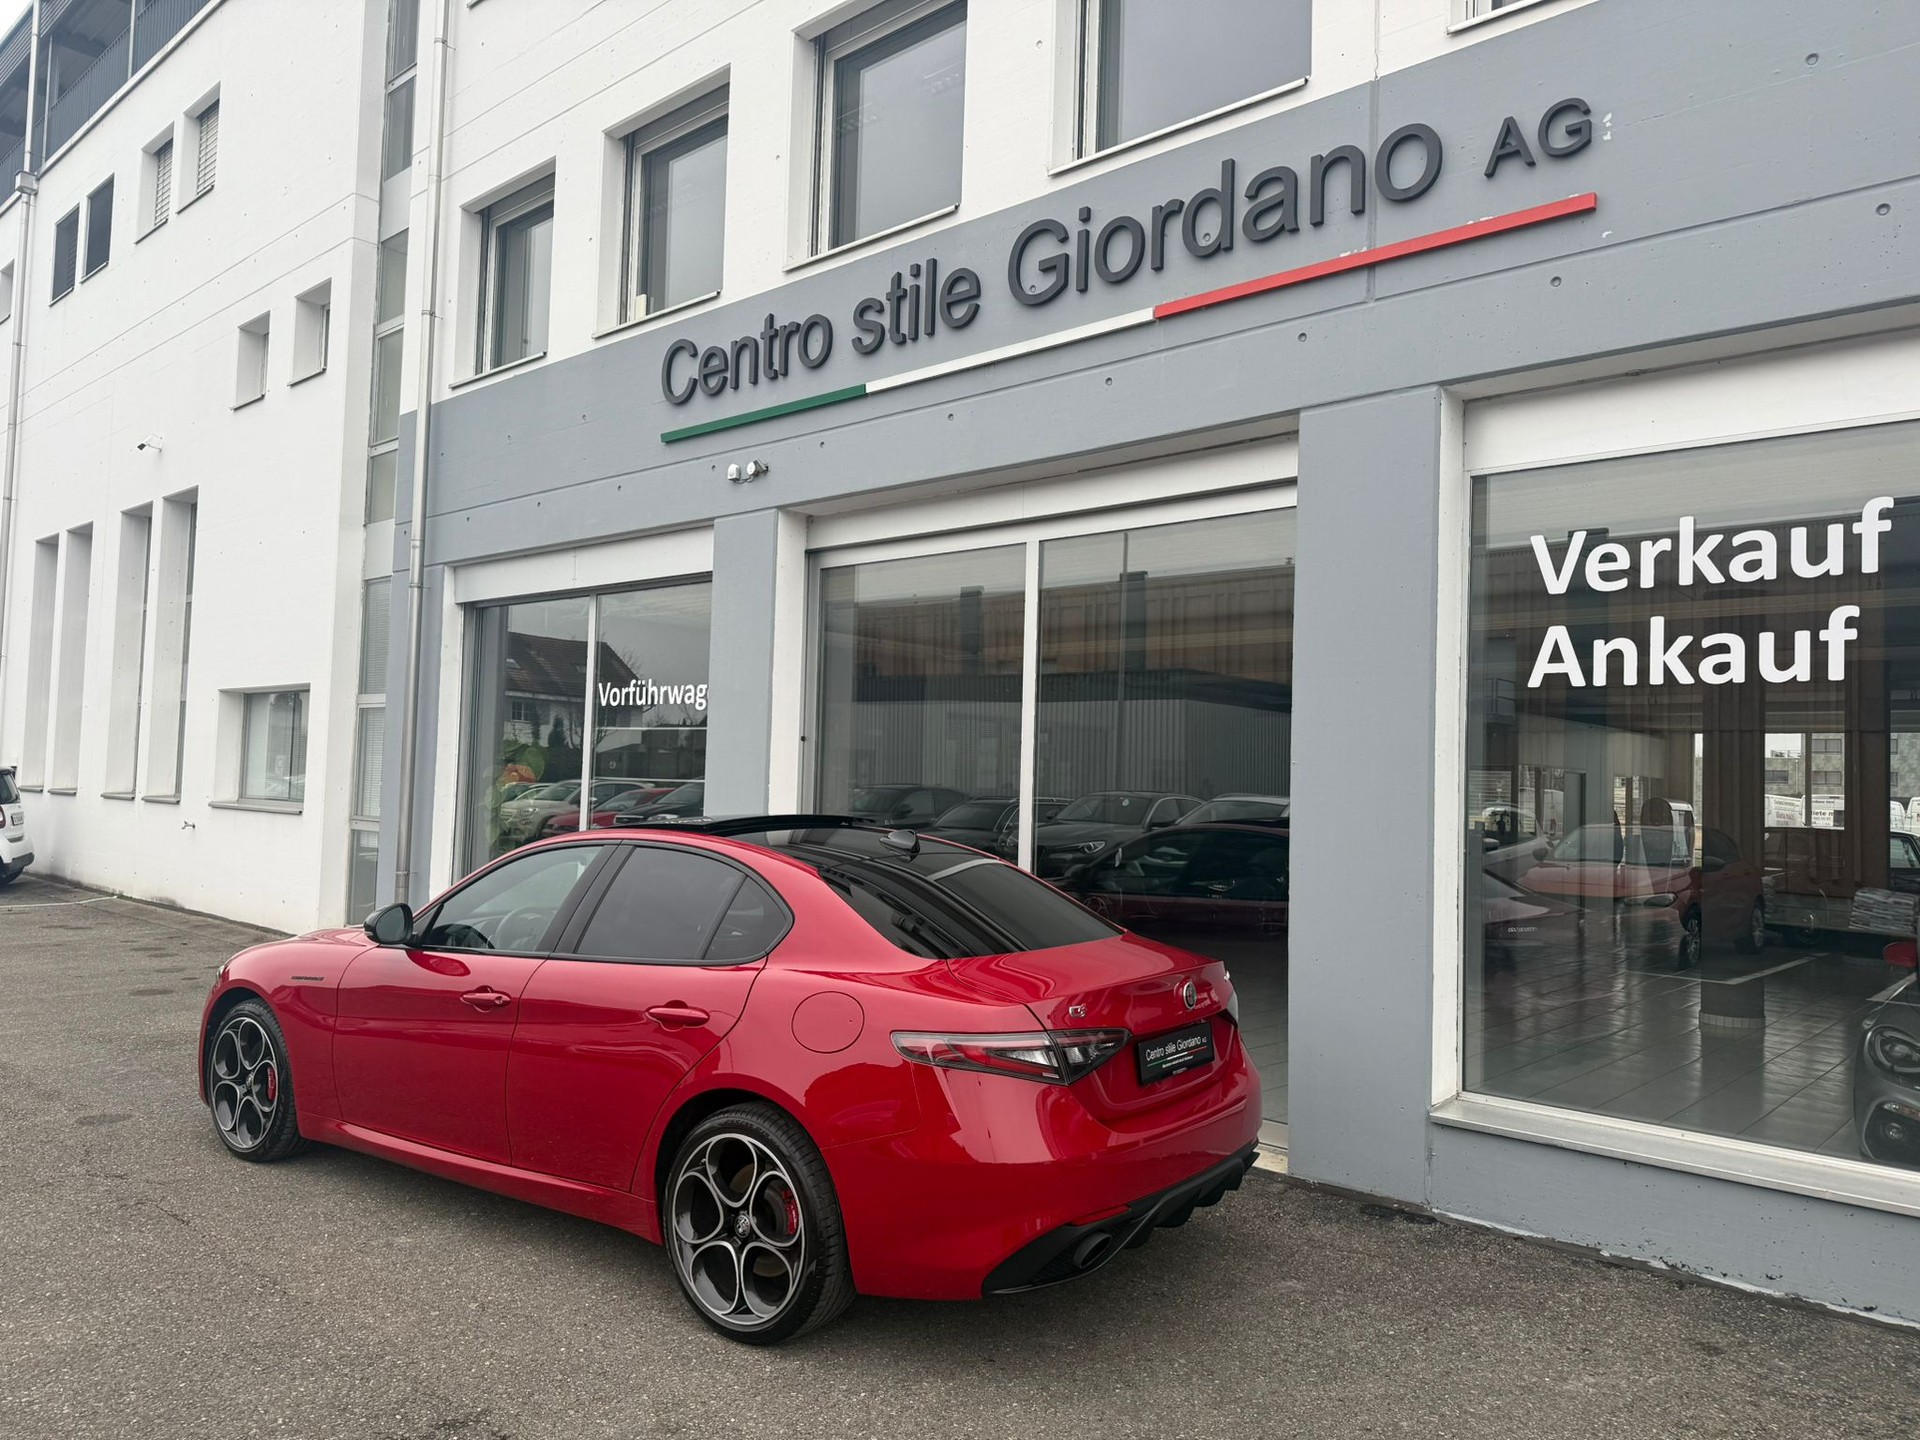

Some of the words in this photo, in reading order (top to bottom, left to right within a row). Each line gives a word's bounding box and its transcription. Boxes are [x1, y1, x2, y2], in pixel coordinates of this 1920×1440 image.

[661, 306, 834, 405] Centro
[851, 258, 981, 355] stile
[1007, 122, 1443, 306] Giordano
[1484, 97, 1592, 178] AG
[1530, 496, 1894, 595] Verkauf
[1527, 605, 1860, 688] Ankauf
[1145, 1047, 1165, 1061] Centro
[1176, 1036, 1201, 1051] Giordano
